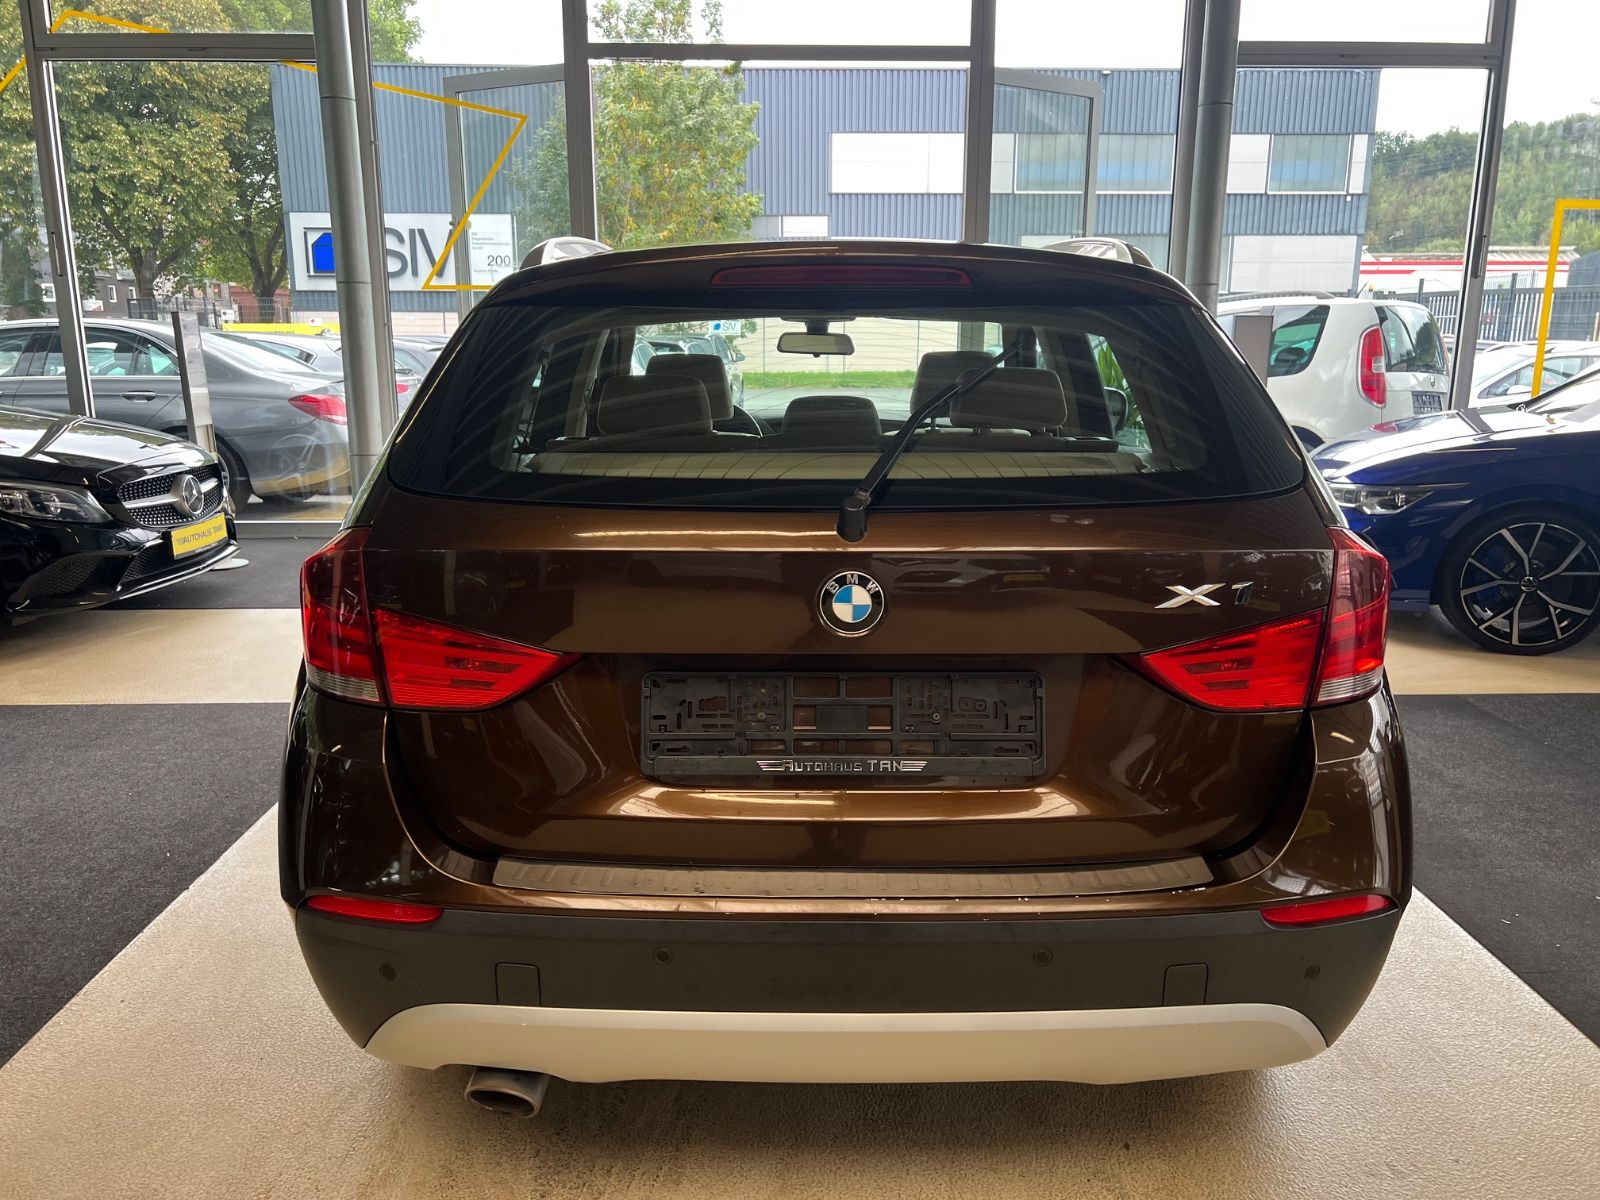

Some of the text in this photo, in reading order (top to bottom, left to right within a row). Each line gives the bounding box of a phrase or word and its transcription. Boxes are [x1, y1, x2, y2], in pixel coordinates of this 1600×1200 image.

[487, 254, 511, 267] 200
[183, 528, 213, 543] AUTOHAUS
[826, 573, 879, 595] BMW
[1154, 581, 1255, 608] X1
[782, 759, 904, 772] AUTOHAUS TAN
